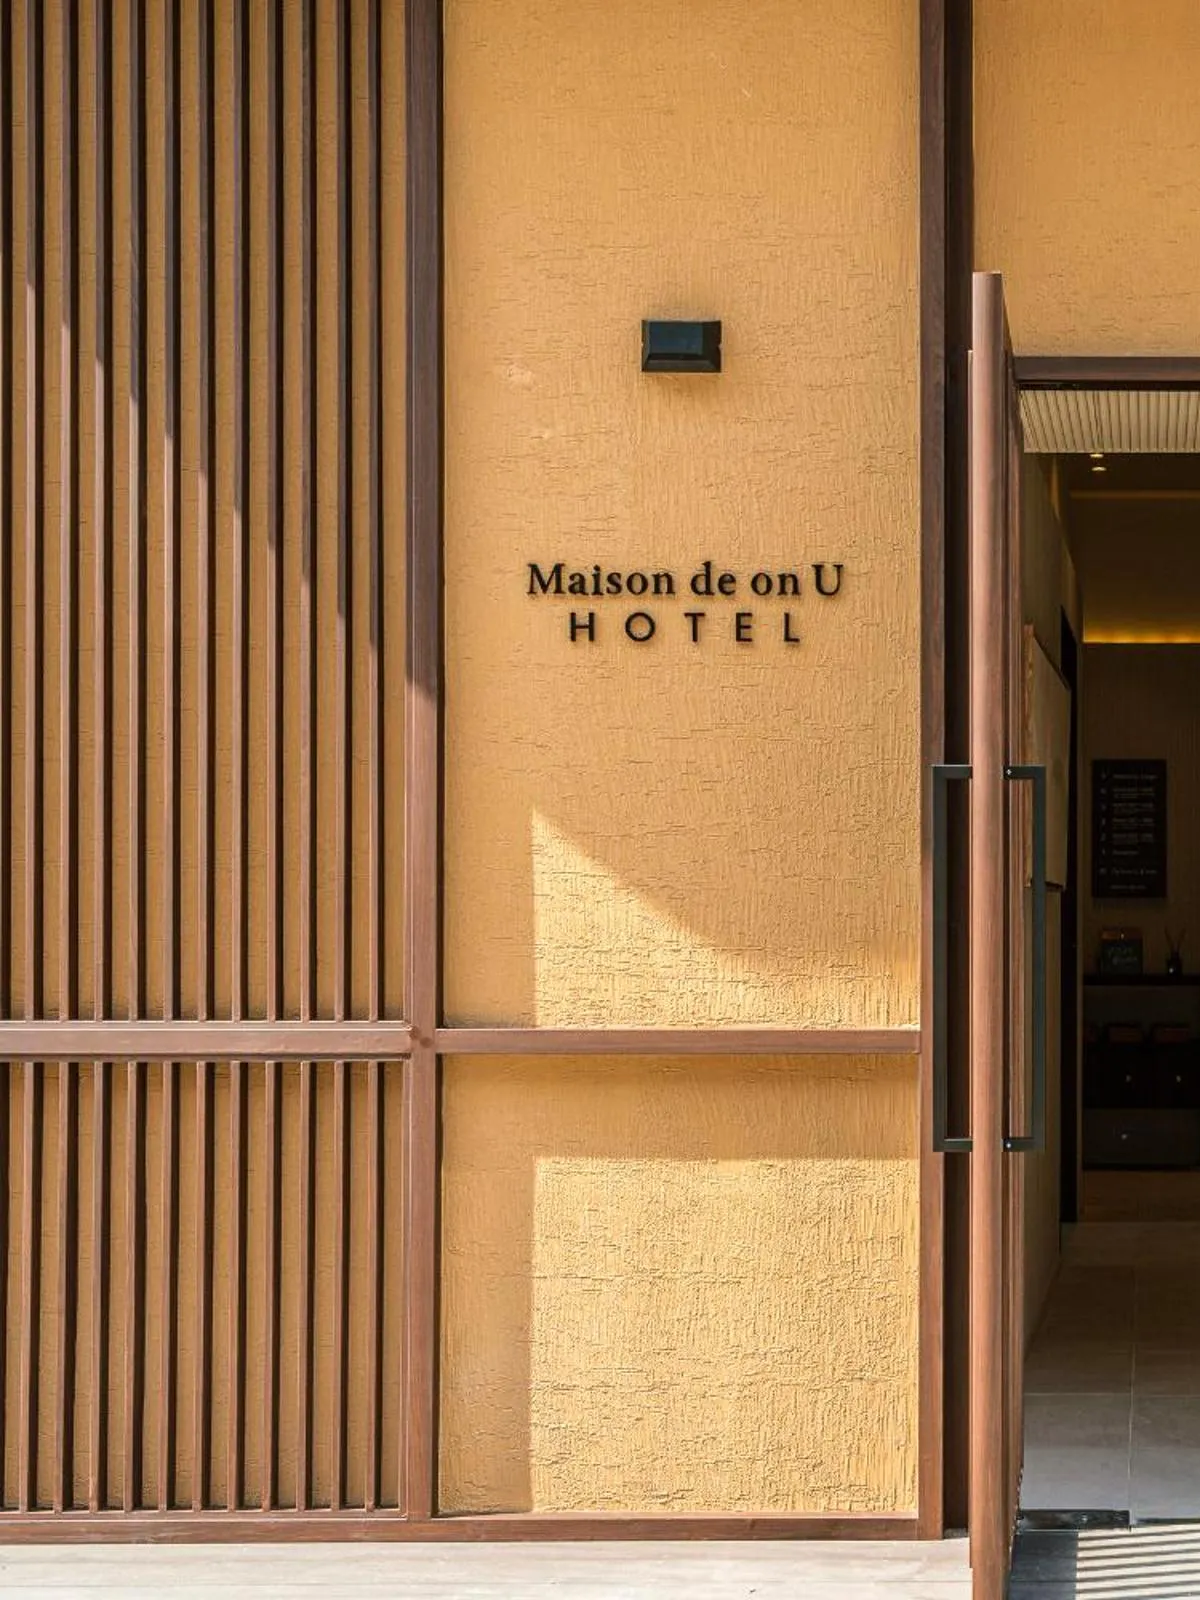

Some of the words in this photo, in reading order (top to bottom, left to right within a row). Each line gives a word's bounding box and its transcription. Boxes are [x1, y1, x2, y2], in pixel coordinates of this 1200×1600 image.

[526, 562, 676, 596] Maison
[690, 560, 737, 596] de
[750, 572, 802, 596] on
[811, 563, 844, 596] U
[568, 612, 801, 642] HOTEL
